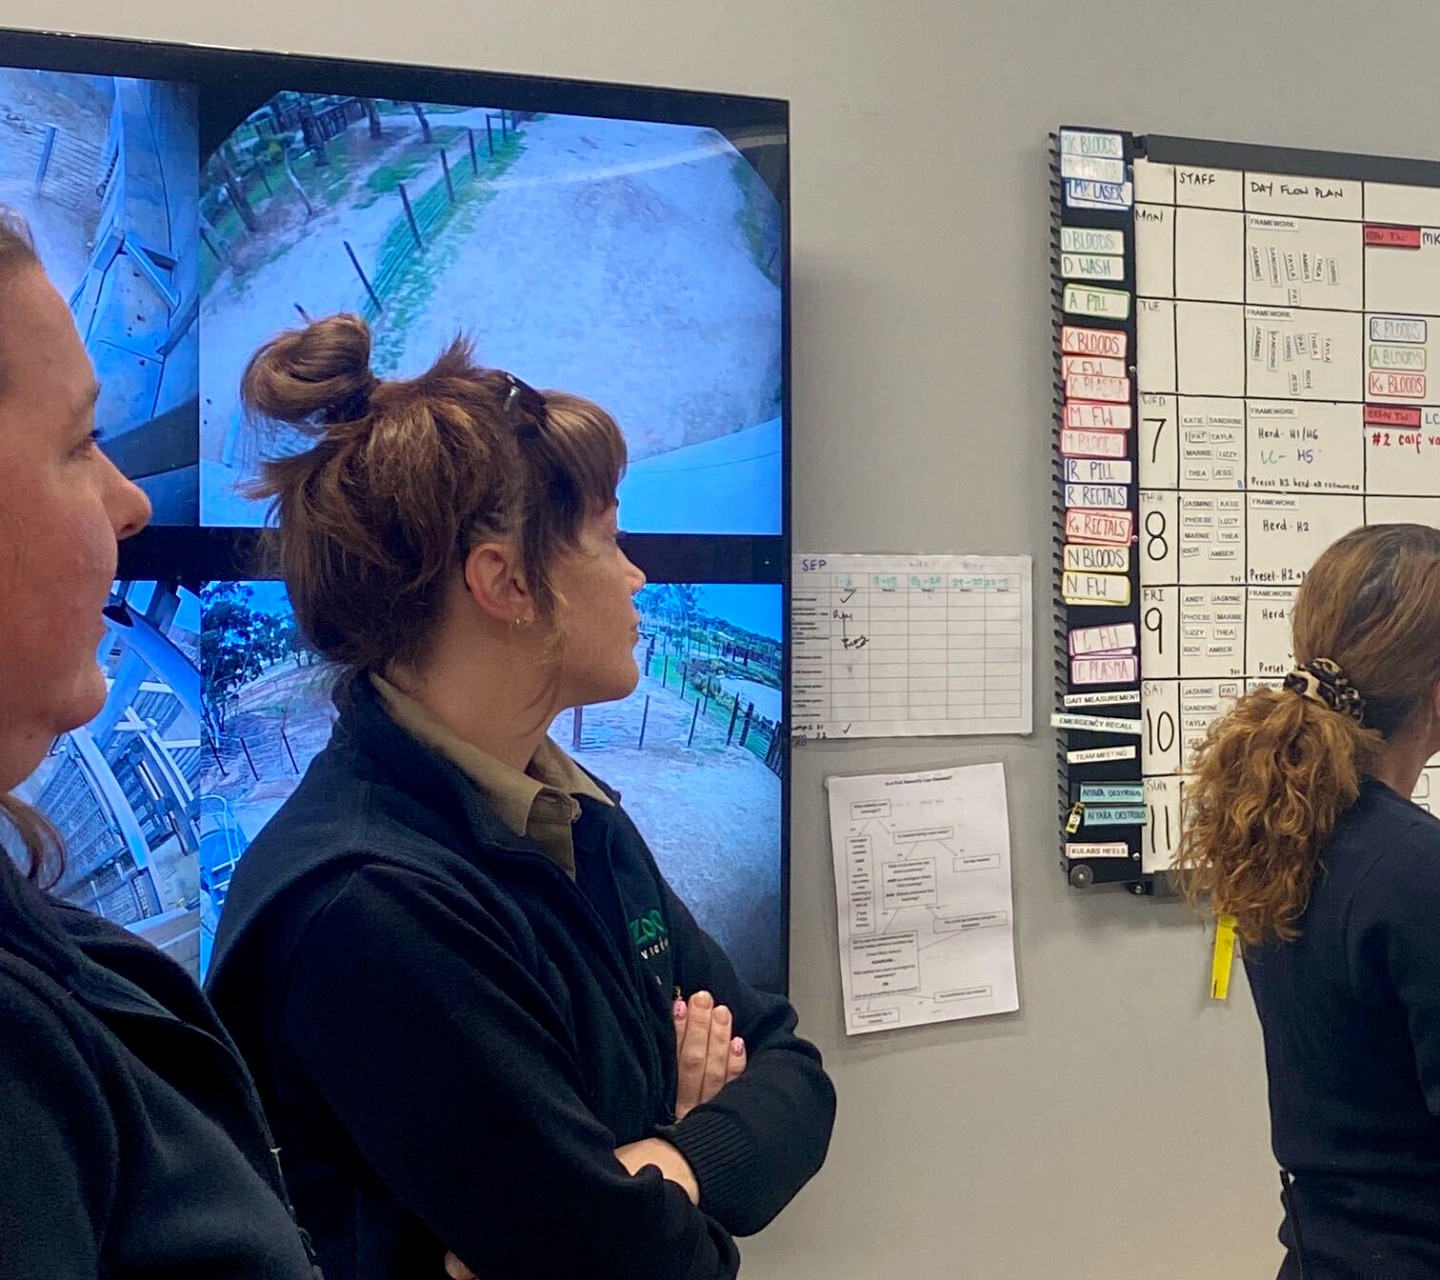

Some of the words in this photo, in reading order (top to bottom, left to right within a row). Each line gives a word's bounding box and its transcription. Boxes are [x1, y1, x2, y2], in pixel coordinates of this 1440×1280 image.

[1180, 172, 1215, 185] STAFF
[1250, 182, 1273, 197] DAY
[1281, 184, 1308, 196] FLOW
[1315, 187, 1343, 199] PLAN
[1250, 219, 1294, 228] FRAMEWORK
[1079, 258, 1112, 276] WASH
[1247, 310, 1291, 319] FRAMEWORK
[1078, 331, 1120, 355] BLOODS
[1387, 374, 1424, 394] BLOODS
[1143, 418, 1167, 463] 7
[1399, 432, 1421, 453] calf
[1070, 461, 1080, 480] R
[1090, 462, 1114, 480] PILL
[1067, 487, 1078, 503] R
[1082, 486, 1125, 506] RECTALS
[1252, 499, 1296, 507] FRAMEWORK
[1085, 516, 1126, 538] RECTALS
[1145, 511, 1168, 561] 8
[802, 559, 827, 572] SEP
[1067, 550, 1080, 567] N
[1083, 550, 1124, 569] BLOODS
[1067, 573, 1078, 593] N
[1086, 576, 1107, 597] FW
[1143, 589, 1164, 601] FRI
[1145, 608, 1163, 654] 9
[1089, 659, 1128, 679] PLASMA
[1084, 692, 1139, 703] MEASUREMENT
[1059, 716, 1103, 728] EMERGENCY
[1147, 709, 1175, 756] 10
[1151, 805, 1171, 854] 11
[1102, 846, 1127, 855] HEELS
[629, 908, 668, 945] ZOO
